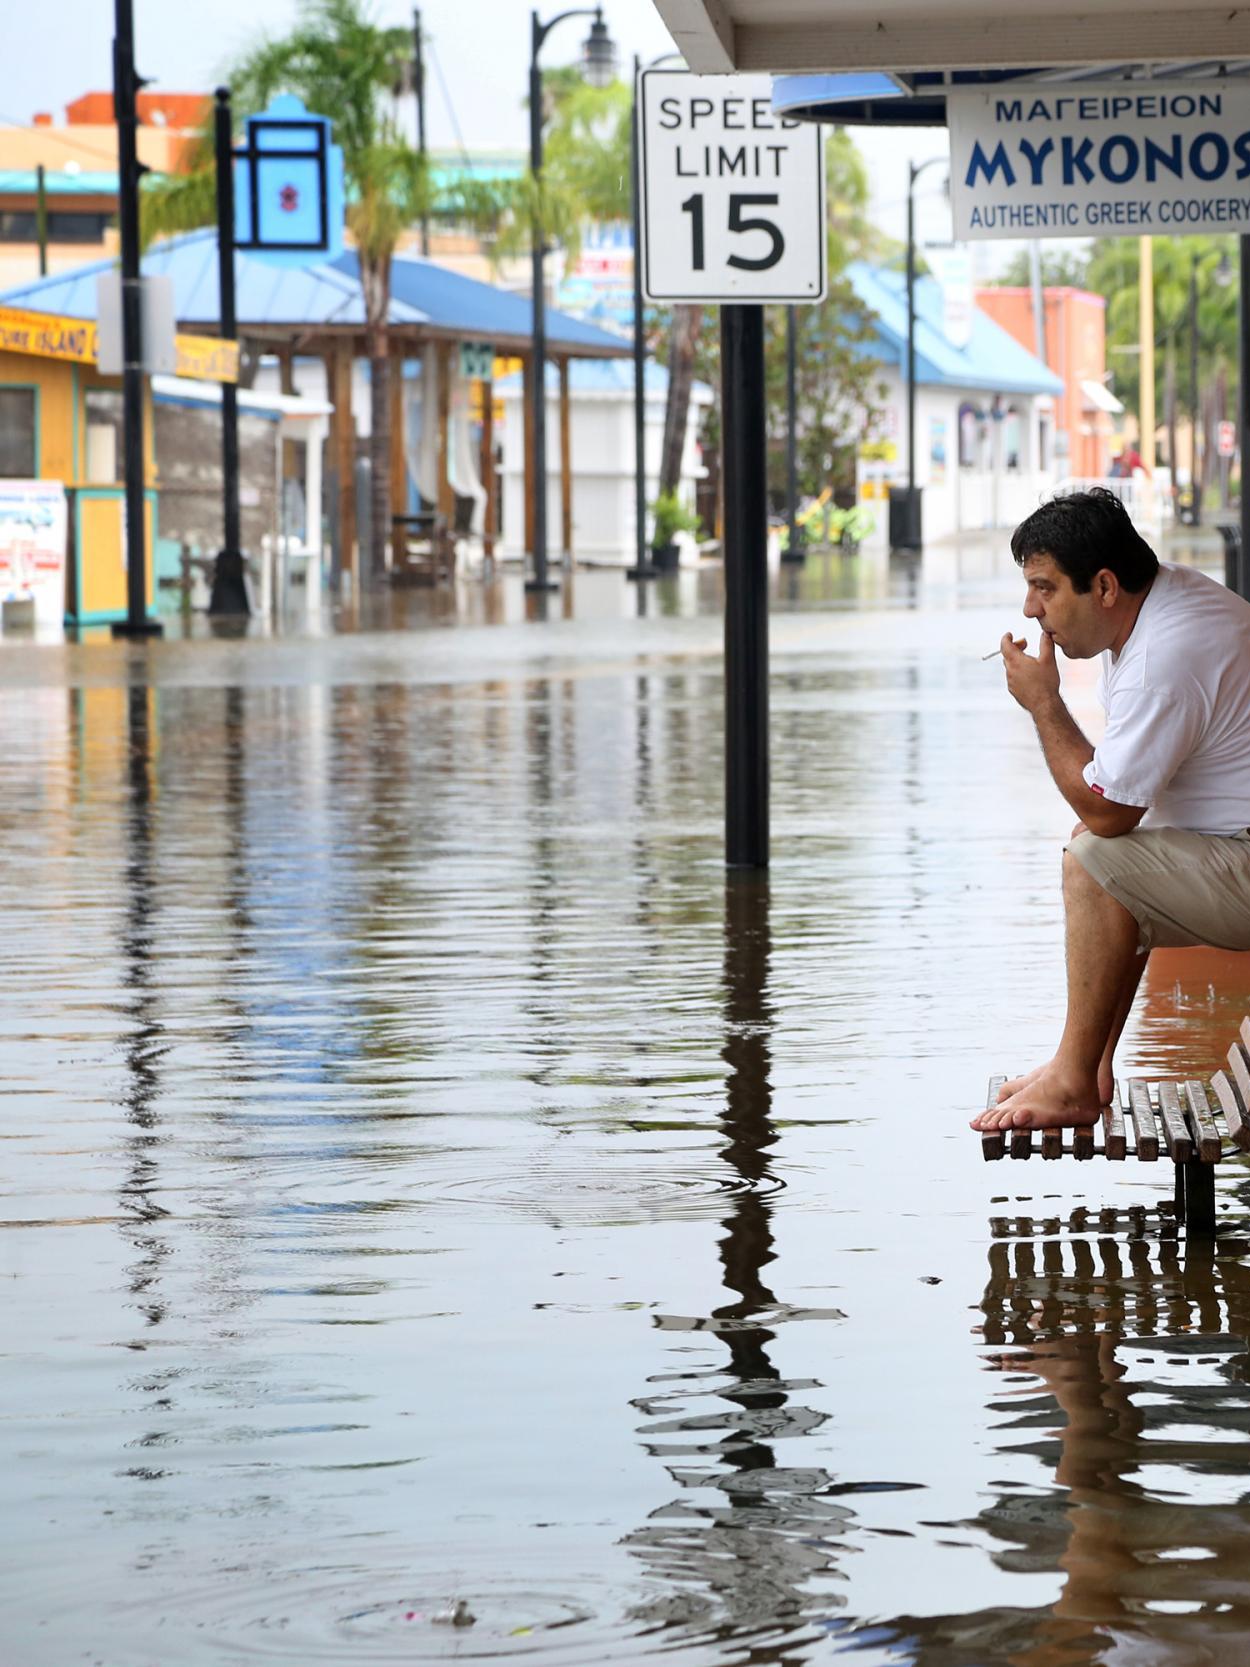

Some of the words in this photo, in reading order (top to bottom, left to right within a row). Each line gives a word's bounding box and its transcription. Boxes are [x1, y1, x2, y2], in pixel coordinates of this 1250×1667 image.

[995, 94, 1222, 122] ΜΑΓΕΙΡΕΙΟΝ
[675, 145, 788, 177] LIMIT
[969, 202, 1080, 229] AUTHENTIC
[1085, 200, 1153, 225] GREEK
[681, 193, 785, 272] 15
